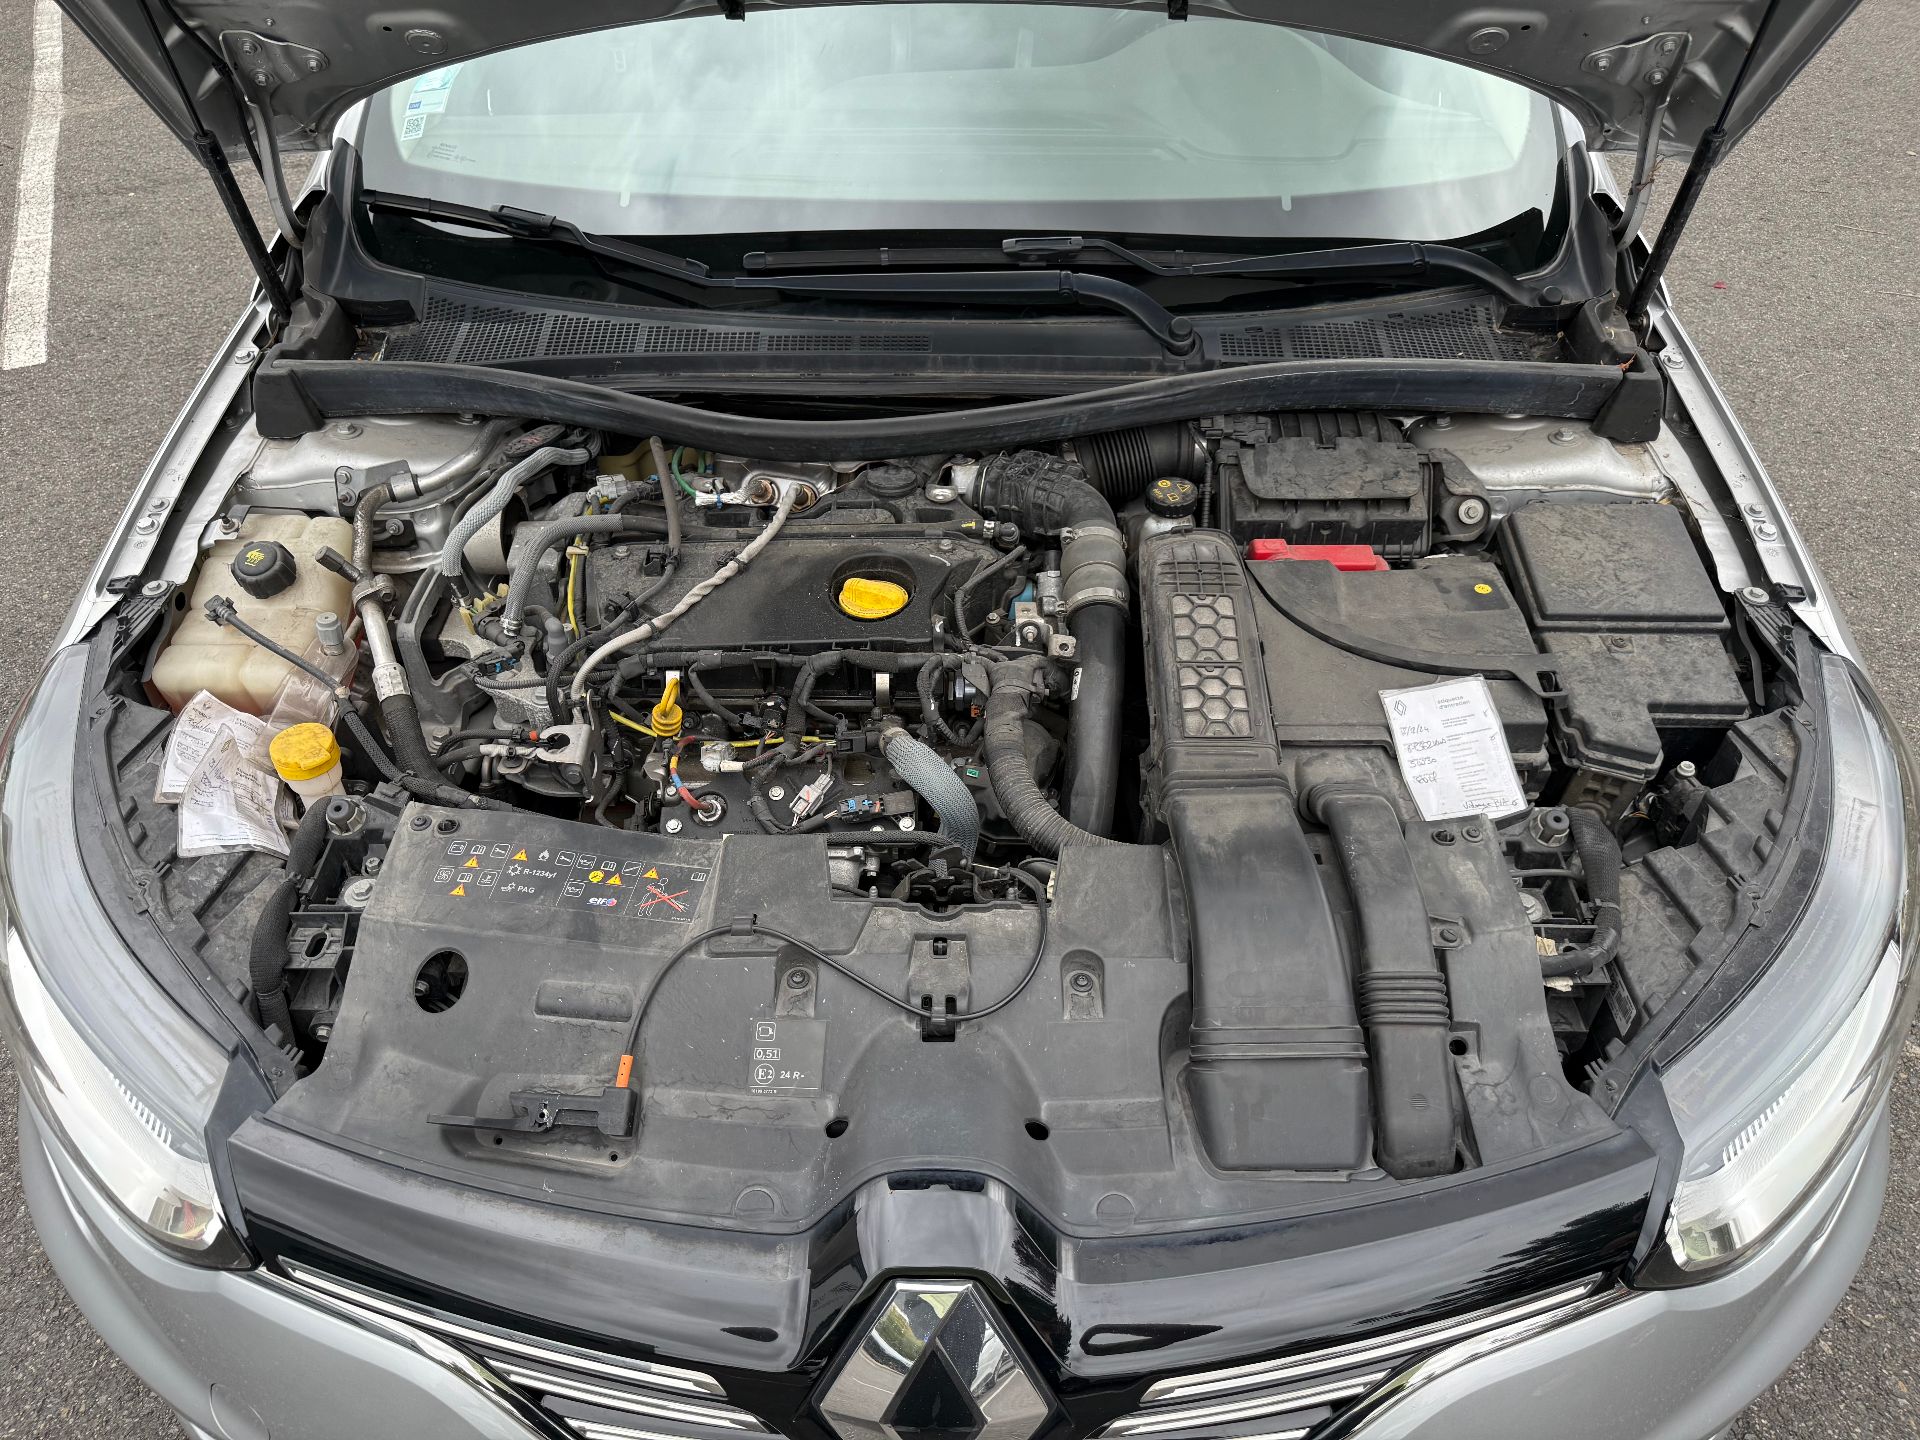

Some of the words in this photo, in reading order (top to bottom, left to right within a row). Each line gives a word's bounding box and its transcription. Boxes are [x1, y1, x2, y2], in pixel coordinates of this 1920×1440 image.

[522, 868, 557, 879] R-1234yf
[517, 886, 536, 894] PAG
[588, 897, 608, 906] elf
[756, 1049, 778, 1059] 0,51
[780, 1070, 791, 1079] 24
